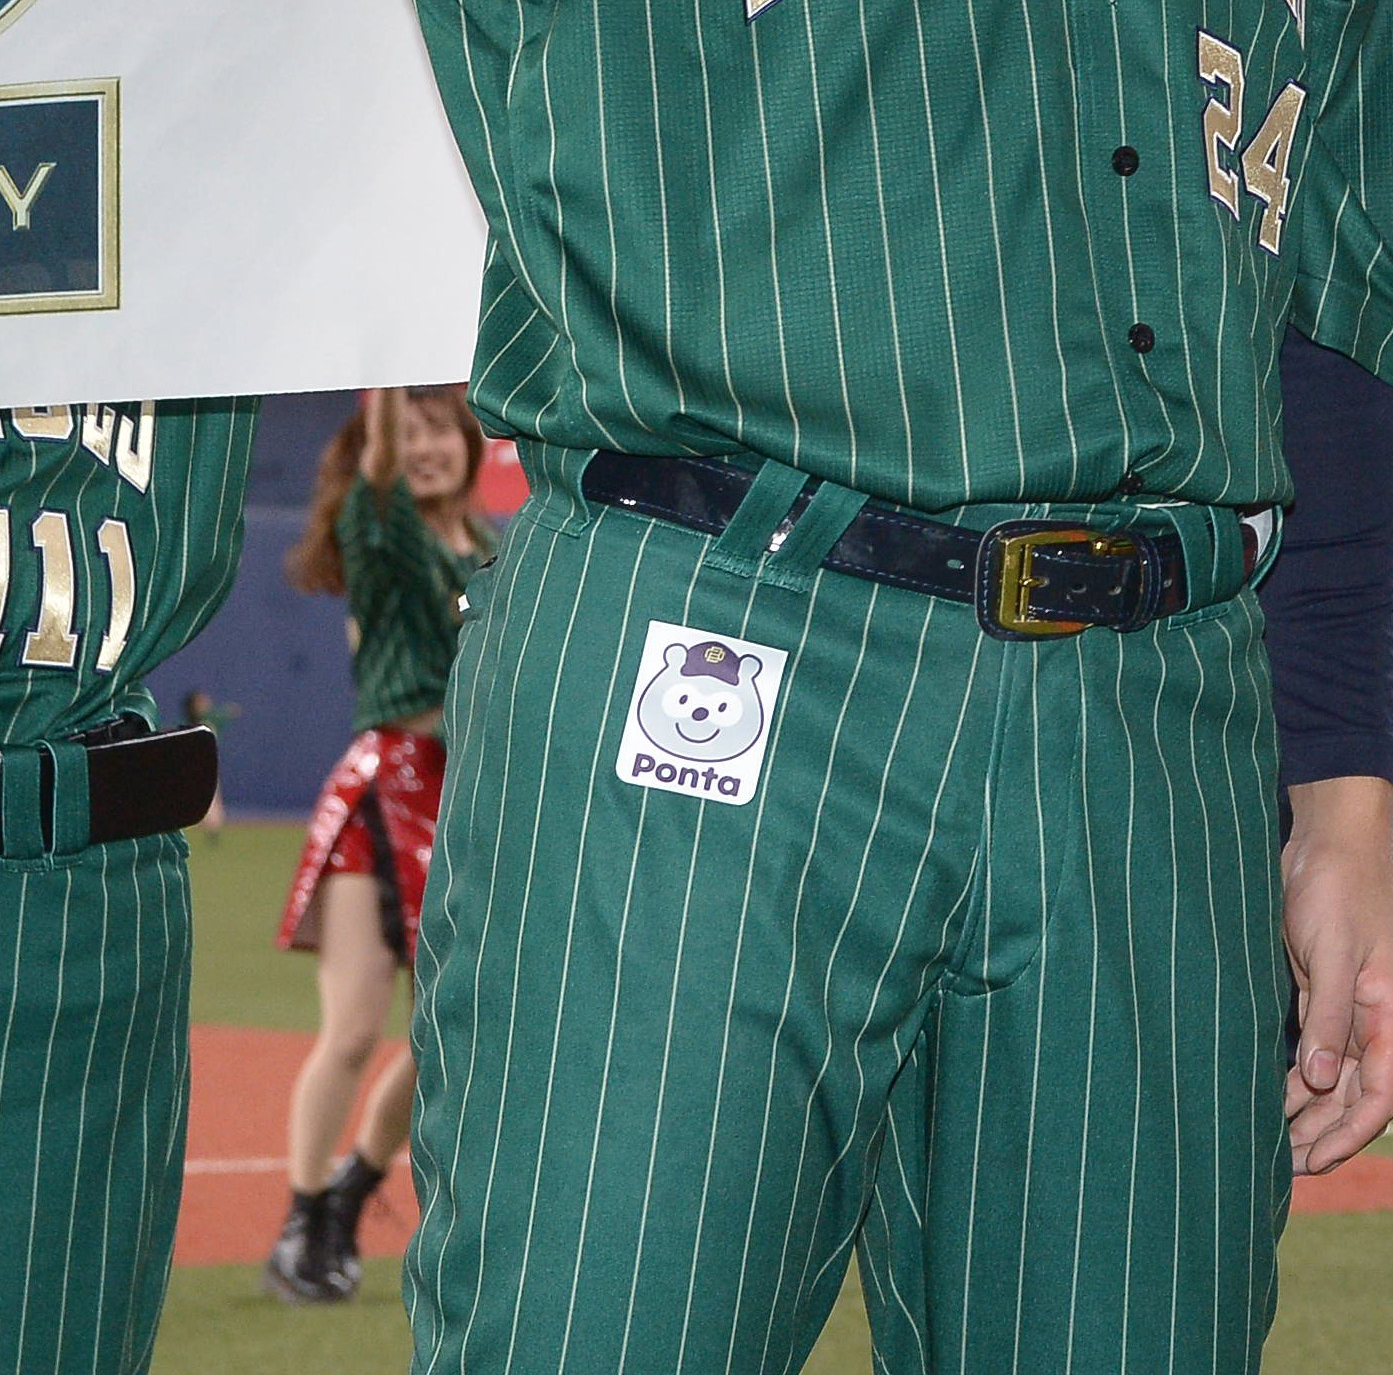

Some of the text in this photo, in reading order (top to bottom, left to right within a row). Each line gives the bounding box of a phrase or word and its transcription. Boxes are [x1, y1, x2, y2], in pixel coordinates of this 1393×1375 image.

[1199, 30, 1306, 257] 24
[0, 508, 137, 671] 11
[631, 752, 742, 798] Ponta
